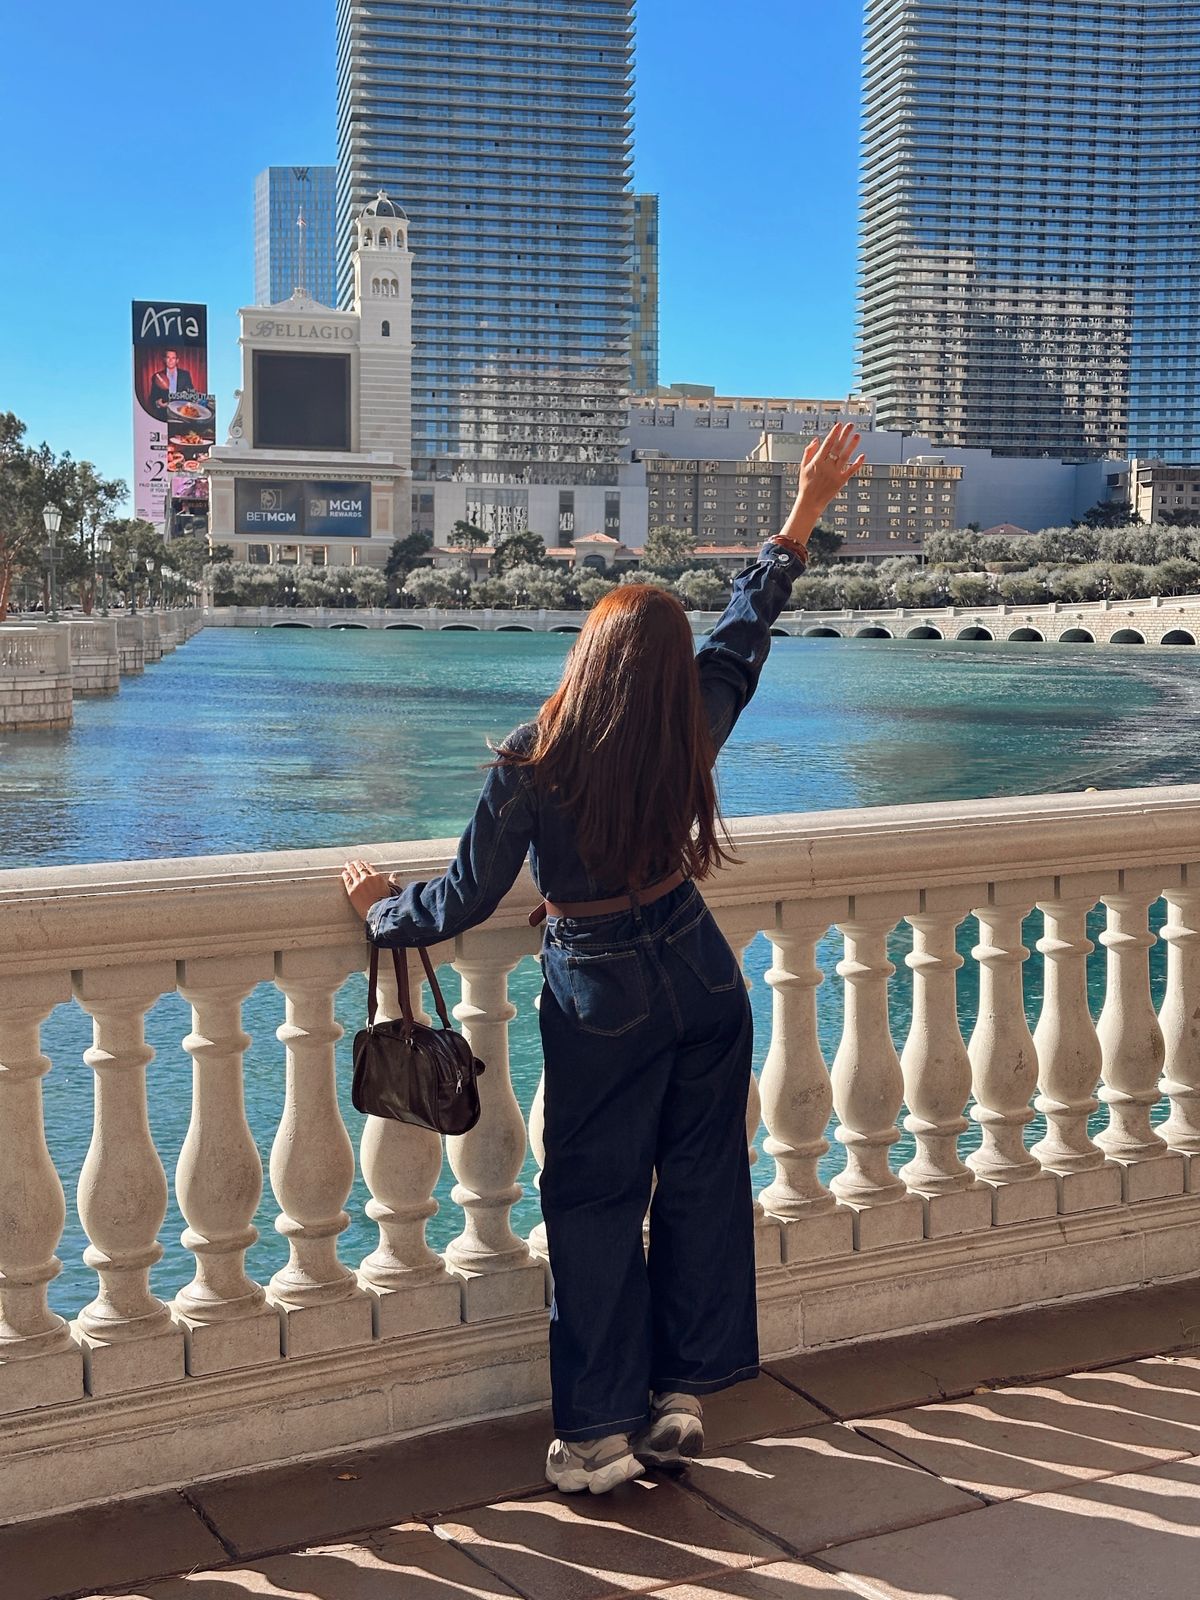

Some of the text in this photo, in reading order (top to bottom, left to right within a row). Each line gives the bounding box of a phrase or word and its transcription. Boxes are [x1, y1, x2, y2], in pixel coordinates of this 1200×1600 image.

[291, 167, 310, 181] W
[141, 306, 199, 338] Aria
[250, 321, 353, 340] BELLAGIO
[329, 500, 362, 511] MGM
[246, 511, 296, 522] BETMGM
